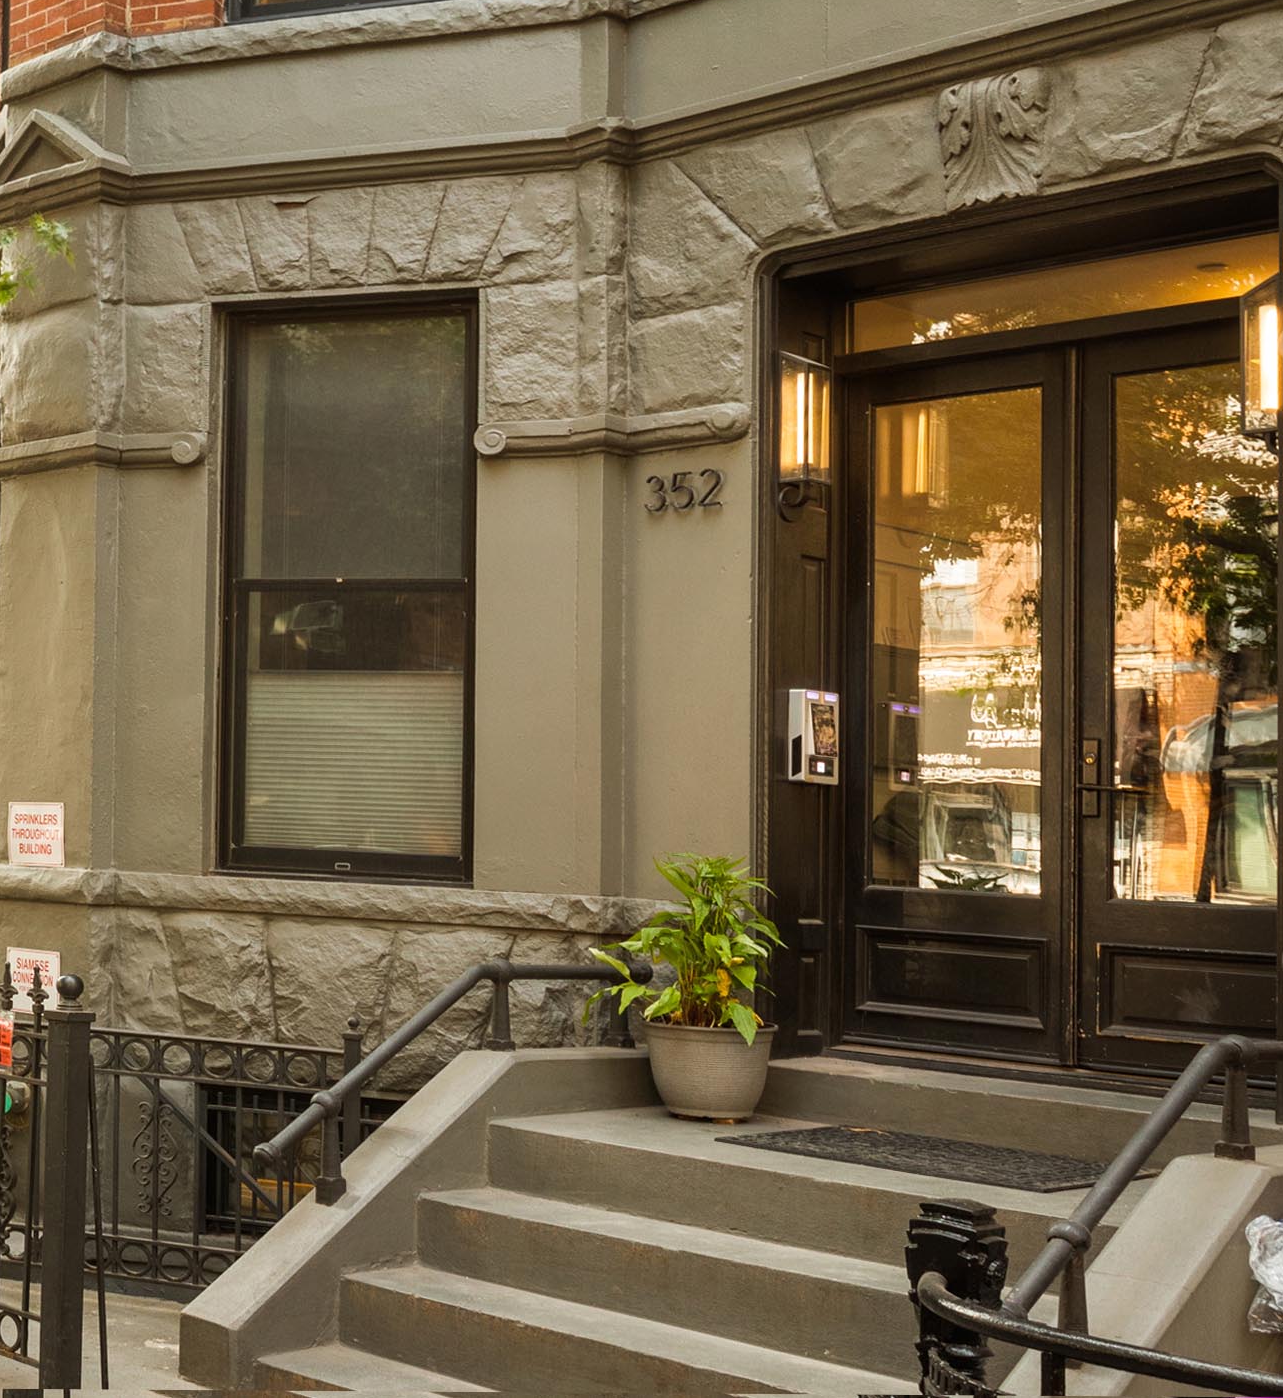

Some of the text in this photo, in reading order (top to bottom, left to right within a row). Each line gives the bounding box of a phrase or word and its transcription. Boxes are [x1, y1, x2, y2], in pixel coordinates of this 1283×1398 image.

[644, 468, 724, 513] 352
[13, 813, 58, 825] SPRINKLERS
[11, 828, 61, 841] THROUGHOUT
[19, 842, 53, 855] BUILDING
[13, 970, 54, 987] CONNEION
